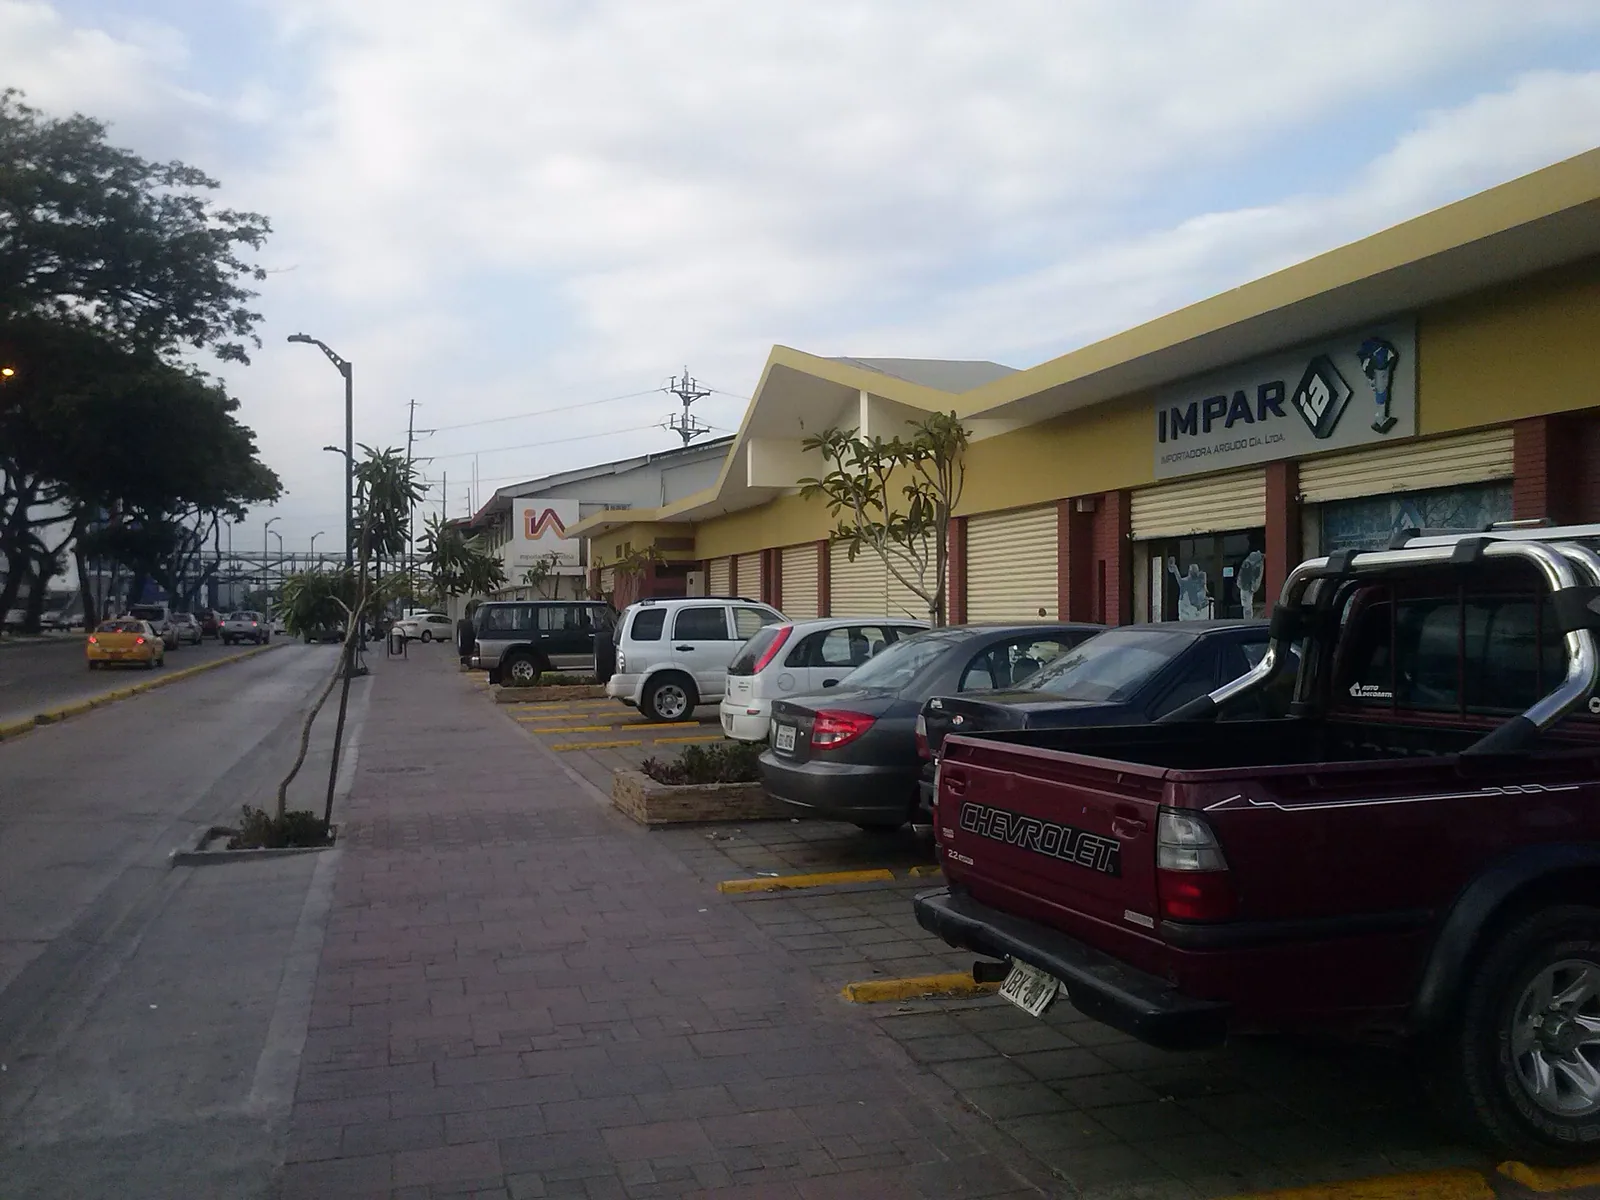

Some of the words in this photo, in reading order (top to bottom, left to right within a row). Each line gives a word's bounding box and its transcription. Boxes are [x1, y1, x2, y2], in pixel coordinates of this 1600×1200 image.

[1158, 380, 1287, 443] IMPAR
[1161, 446, 1212, 464] IMPORTADORA
[1213, 438, 1248, 454] ARGUDO
[960, 802, 1120, 872] CHEVROLET
